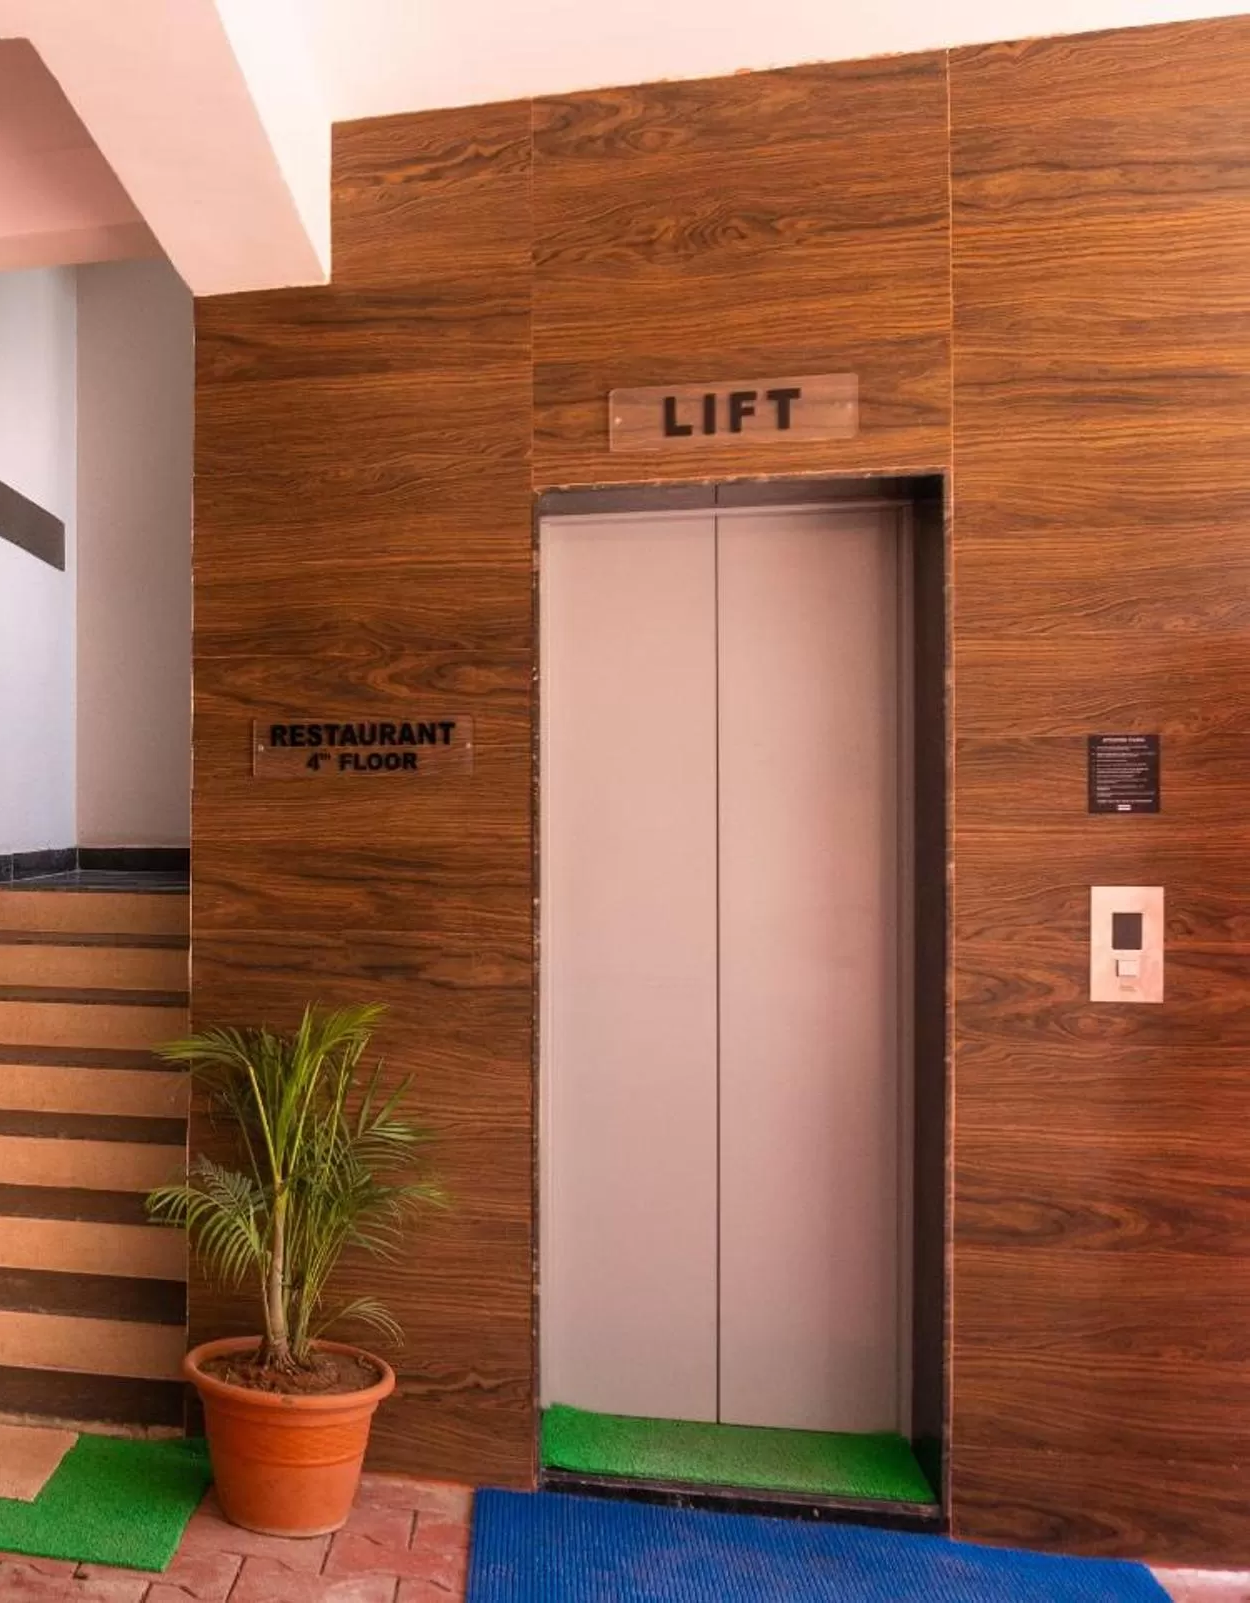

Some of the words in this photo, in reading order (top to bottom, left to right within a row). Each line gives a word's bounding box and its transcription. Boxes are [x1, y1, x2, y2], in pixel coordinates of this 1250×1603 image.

[664, 387, 801, 437] LIFT
[270, 722, 455, 746] RESTAURANT
[340, 753, 418, 771] FLOOR
